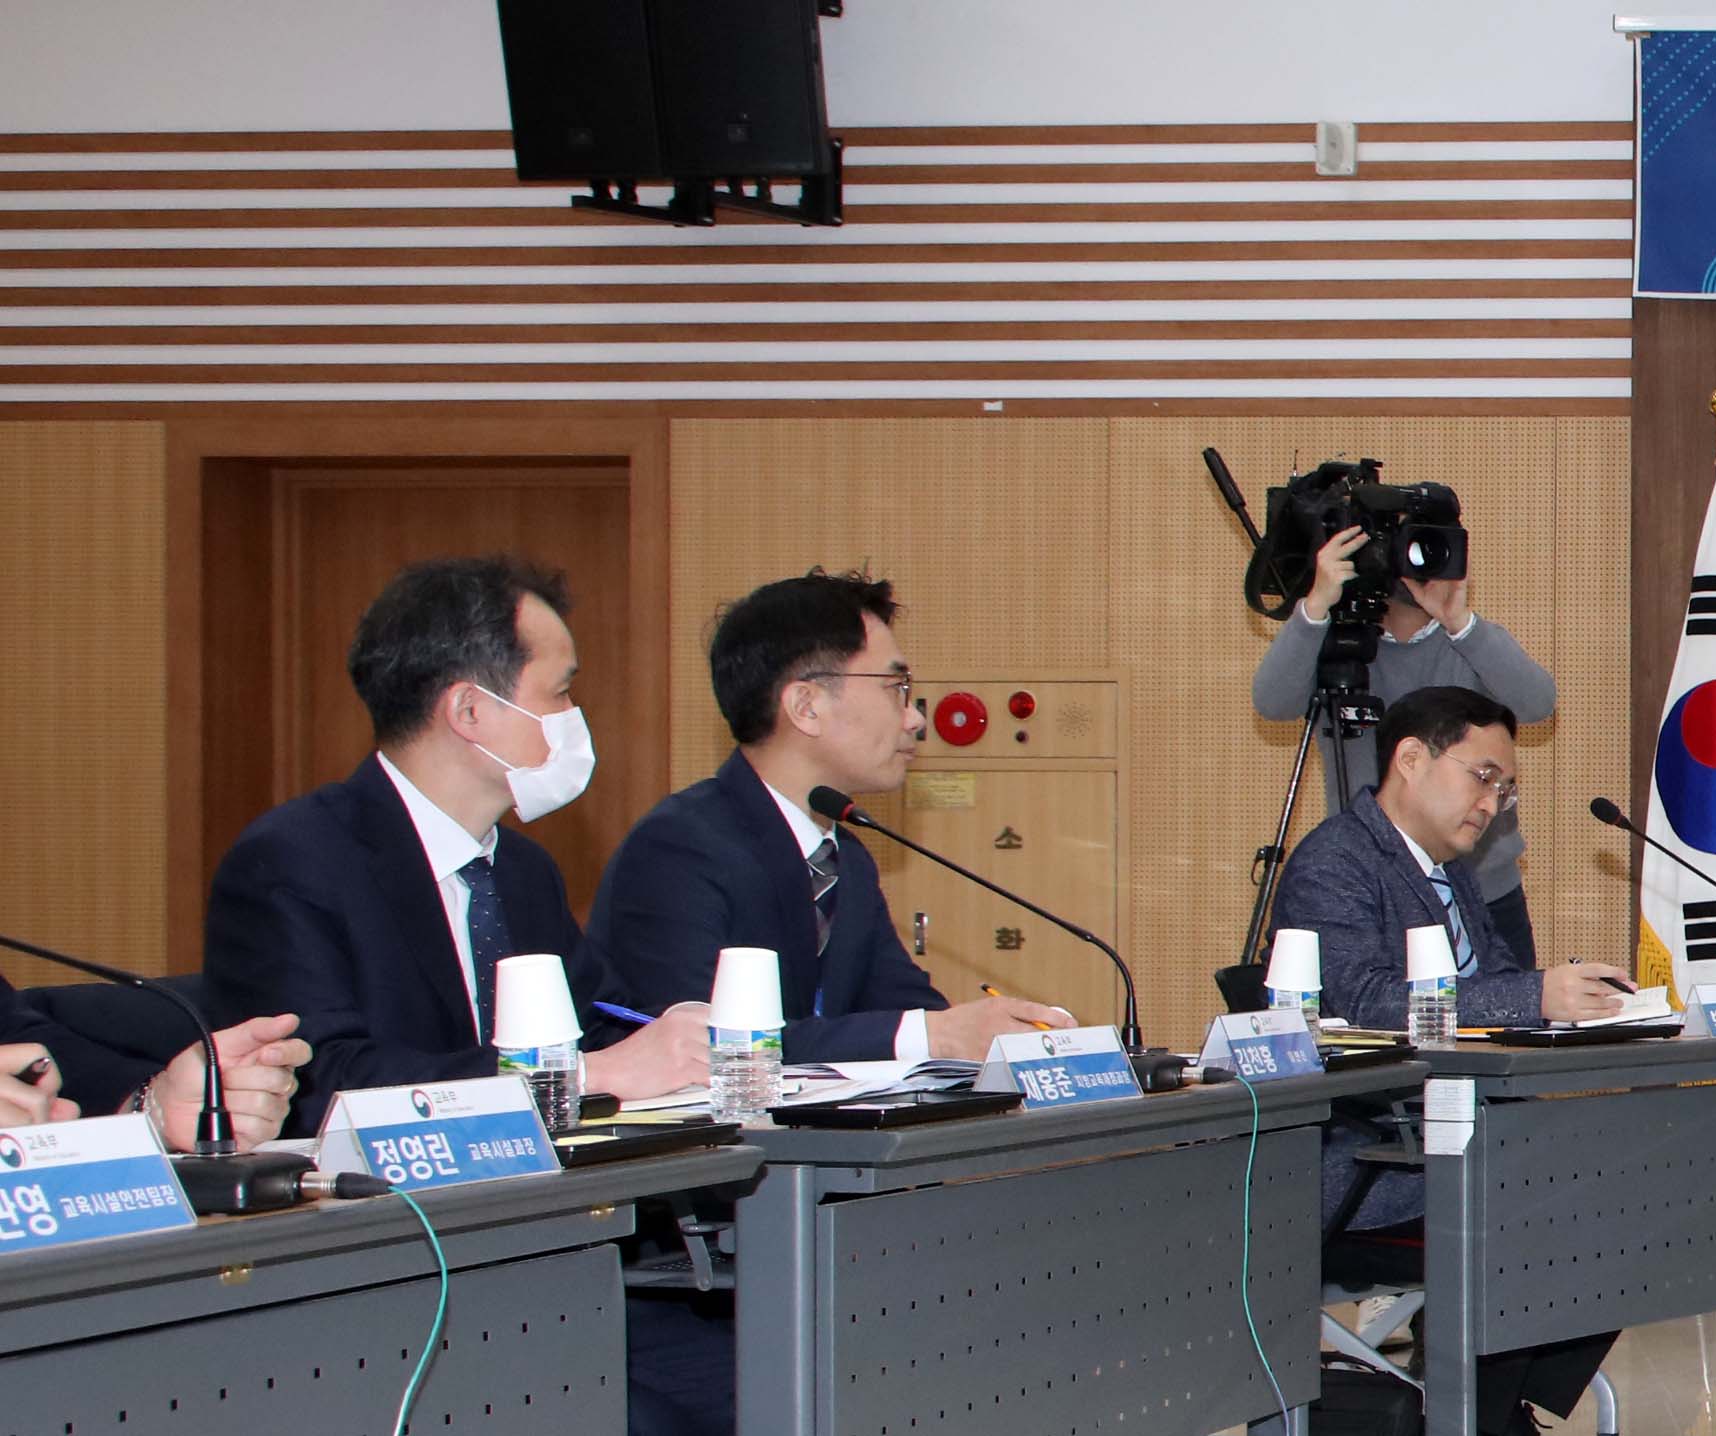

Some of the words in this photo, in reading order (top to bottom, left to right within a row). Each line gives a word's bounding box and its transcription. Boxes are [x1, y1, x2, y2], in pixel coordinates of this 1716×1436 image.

[1017, 1066, 1077, 1102] 채홍준
[371, 1131, 461, 1185] 정영린
[467, 1136, 537, 1162] 교육시설과장
[59, 1183, 178, 1219] 교육시설안전팀장
